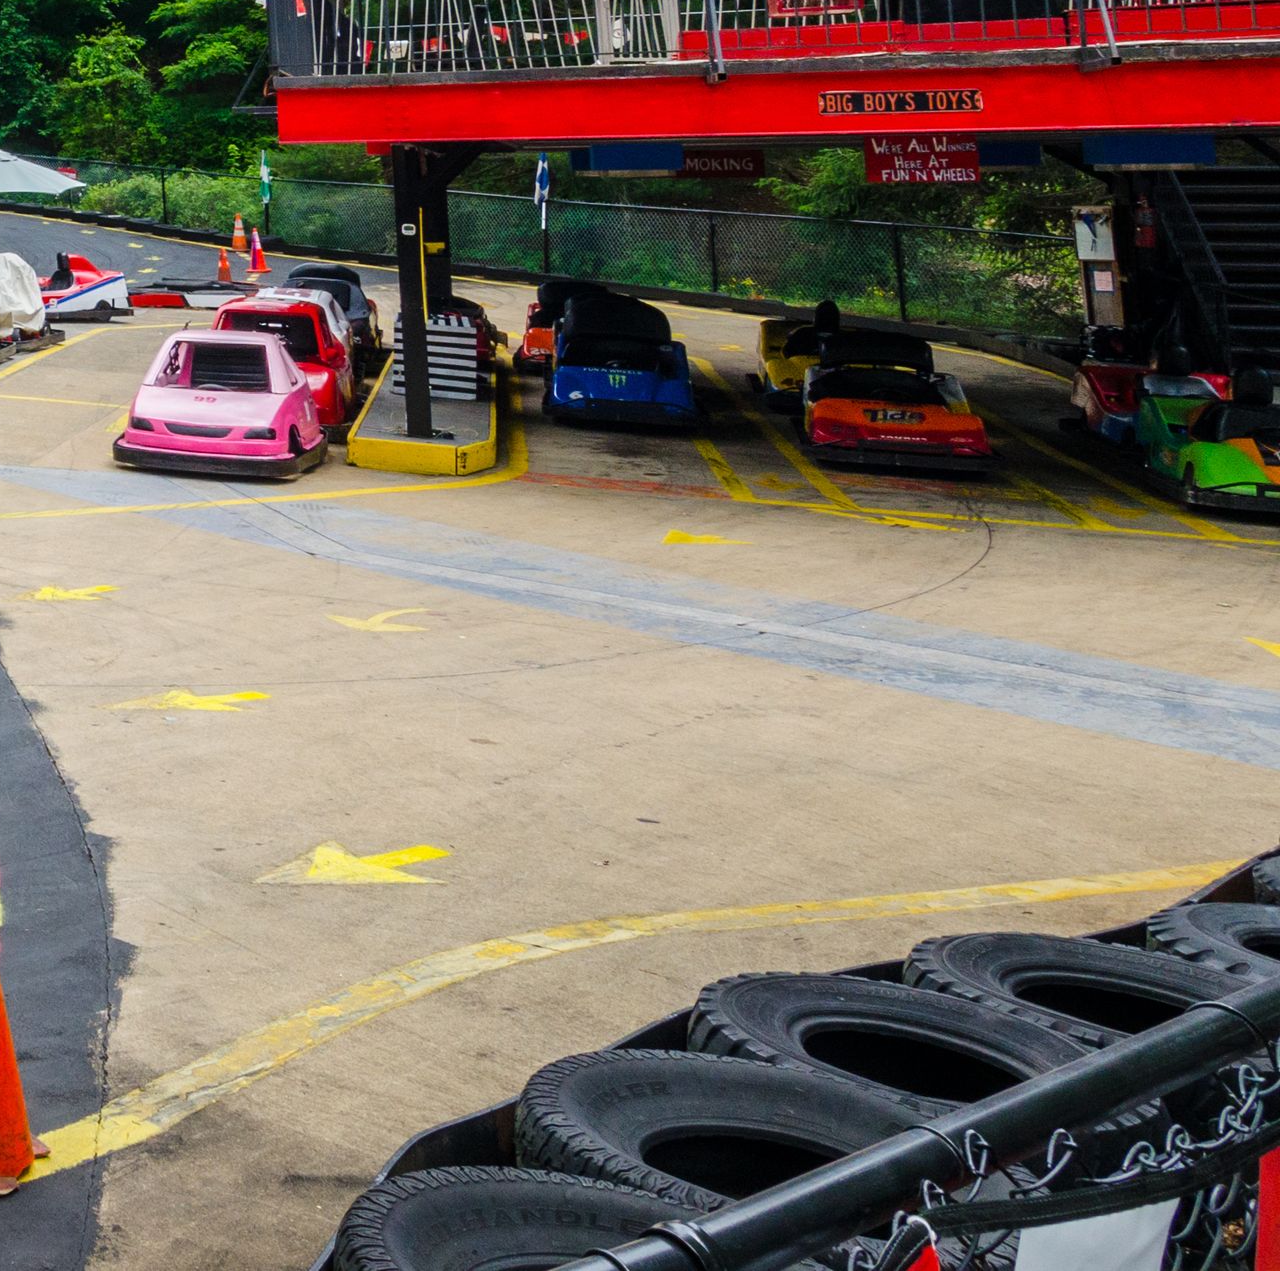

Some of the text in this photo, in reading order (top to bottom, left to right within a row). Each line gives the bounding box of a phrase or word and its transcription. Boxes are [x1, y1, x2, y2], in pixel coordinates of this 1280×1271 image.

[826, 91, 972, 112] BIG BOY'S TOYS
[907, 138, 930, 153] ALL
[684, 157, 754, 171] MOKING
[894, 154, 949, 169] HERE AT
[881, 170, 909, 182] FUN
[932, 168, 976, 181] WHEELS
